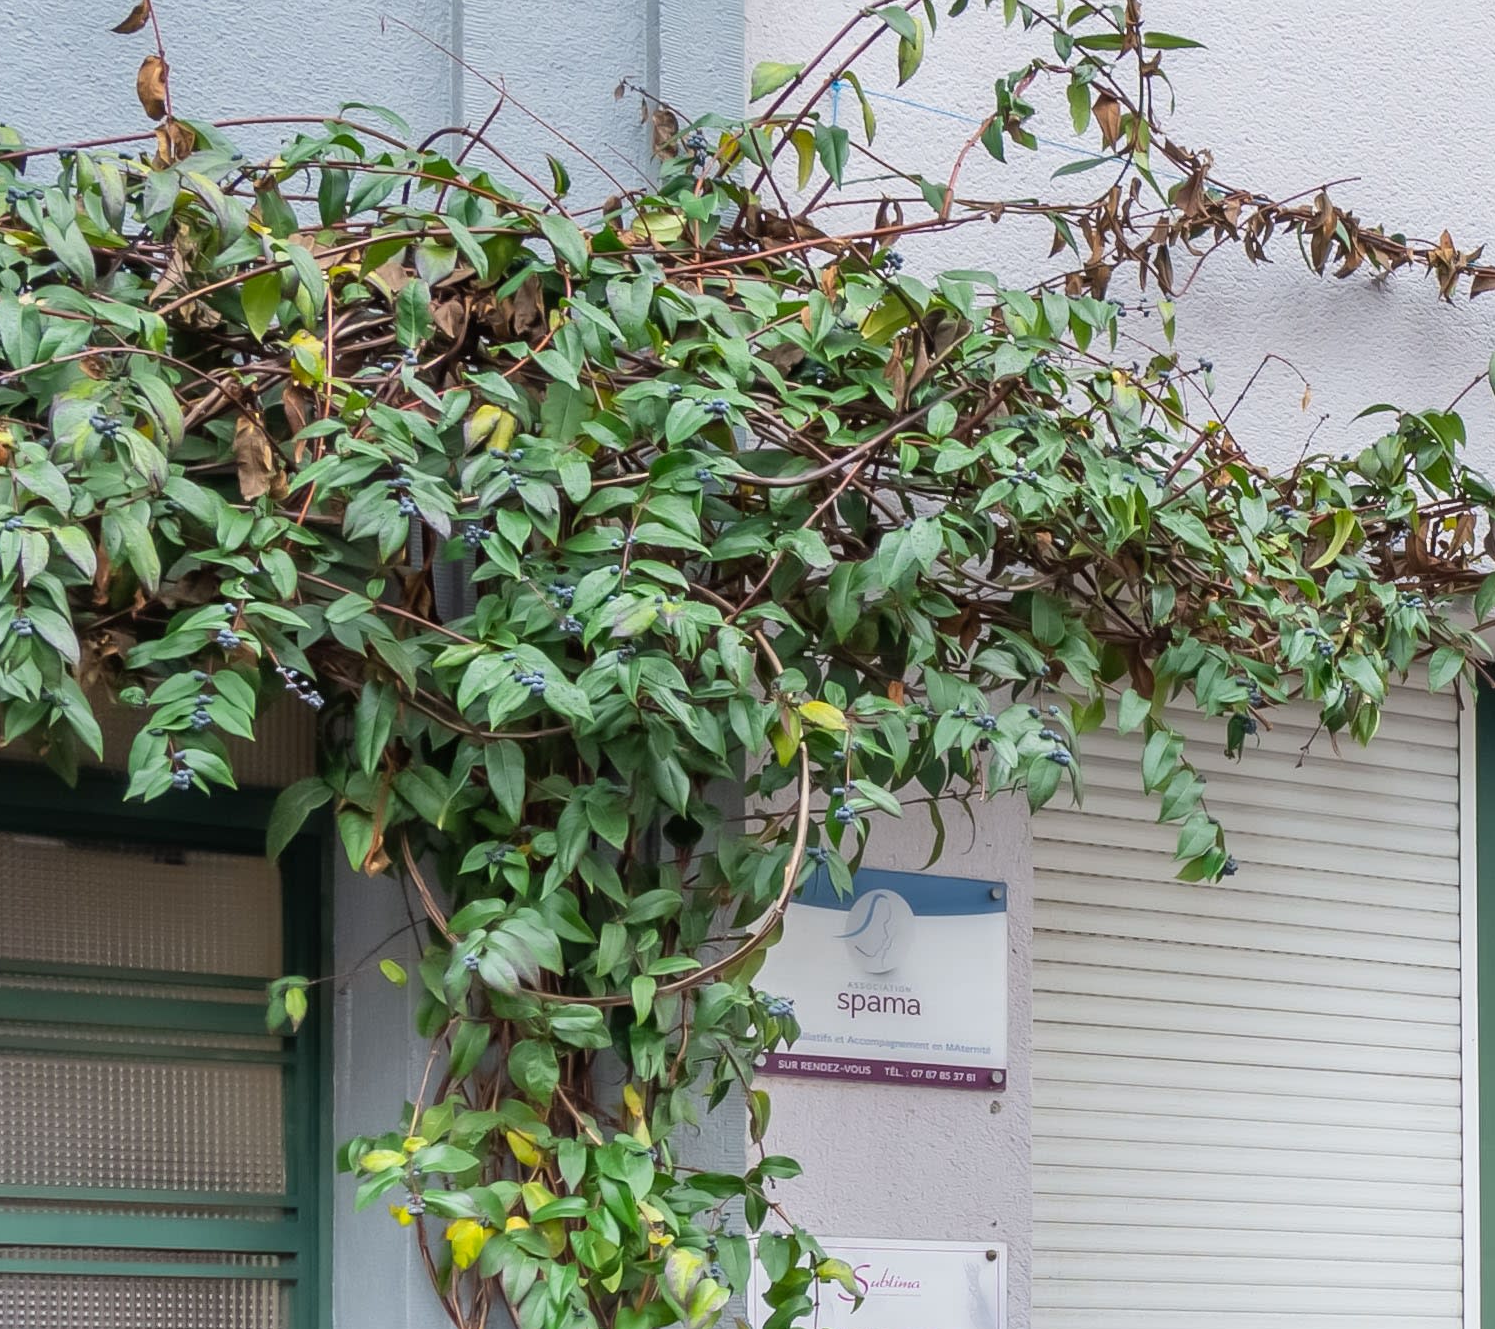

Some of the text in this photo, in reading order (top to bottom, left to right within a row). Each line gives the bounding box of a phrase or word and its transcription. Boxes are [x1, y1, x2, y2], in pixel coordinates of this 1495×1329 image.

[847, 981, 913, 992] ASSOCIATION
[837, 992, 921, 1018] spama
[835, 1035, 844, 1044] et
[847, 1036, 930, 1050] Accompagnement
[932, 1042, 943, 1051] en
[778, 1060, 798, 1071] SUR
[800, 1062, 872, 1075] RENDEZ-VOUS
[911, 1069, 923, 1078] 07
[838, 1264, 921, 1302] Sublima
